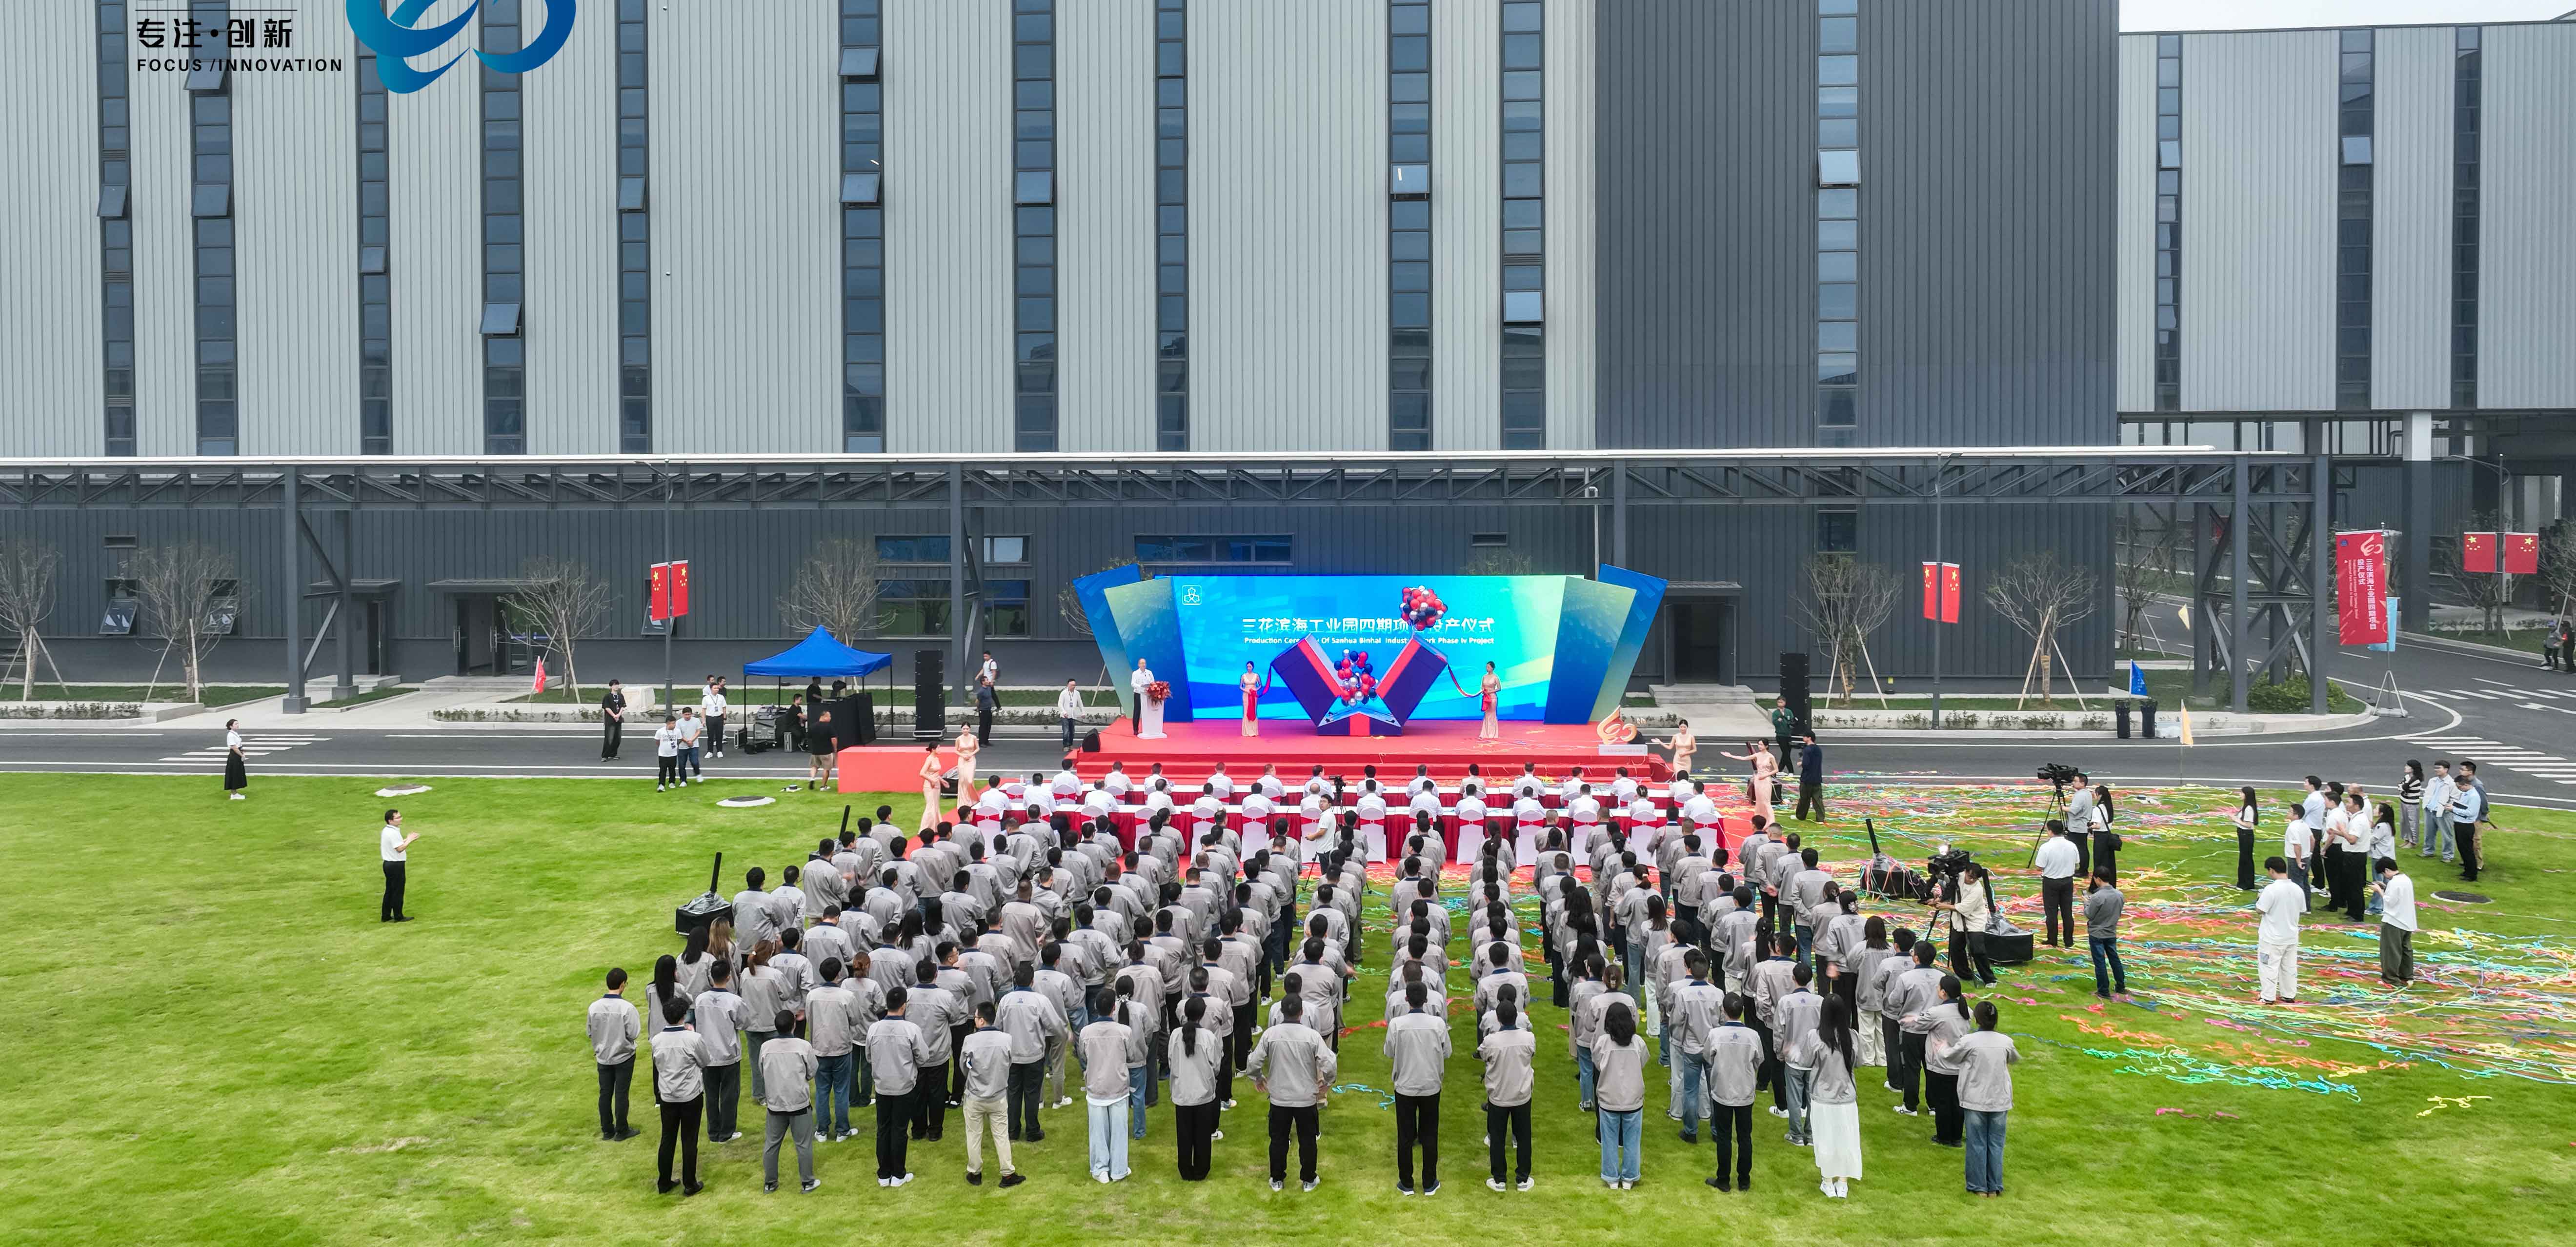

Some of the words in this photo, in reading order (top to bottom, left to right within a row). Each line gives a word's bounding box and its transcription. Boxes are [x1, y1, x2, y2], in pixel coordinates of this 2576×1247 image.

[1241, 618, 1494, 633] 三花滨海工业园四期项投产仪式
